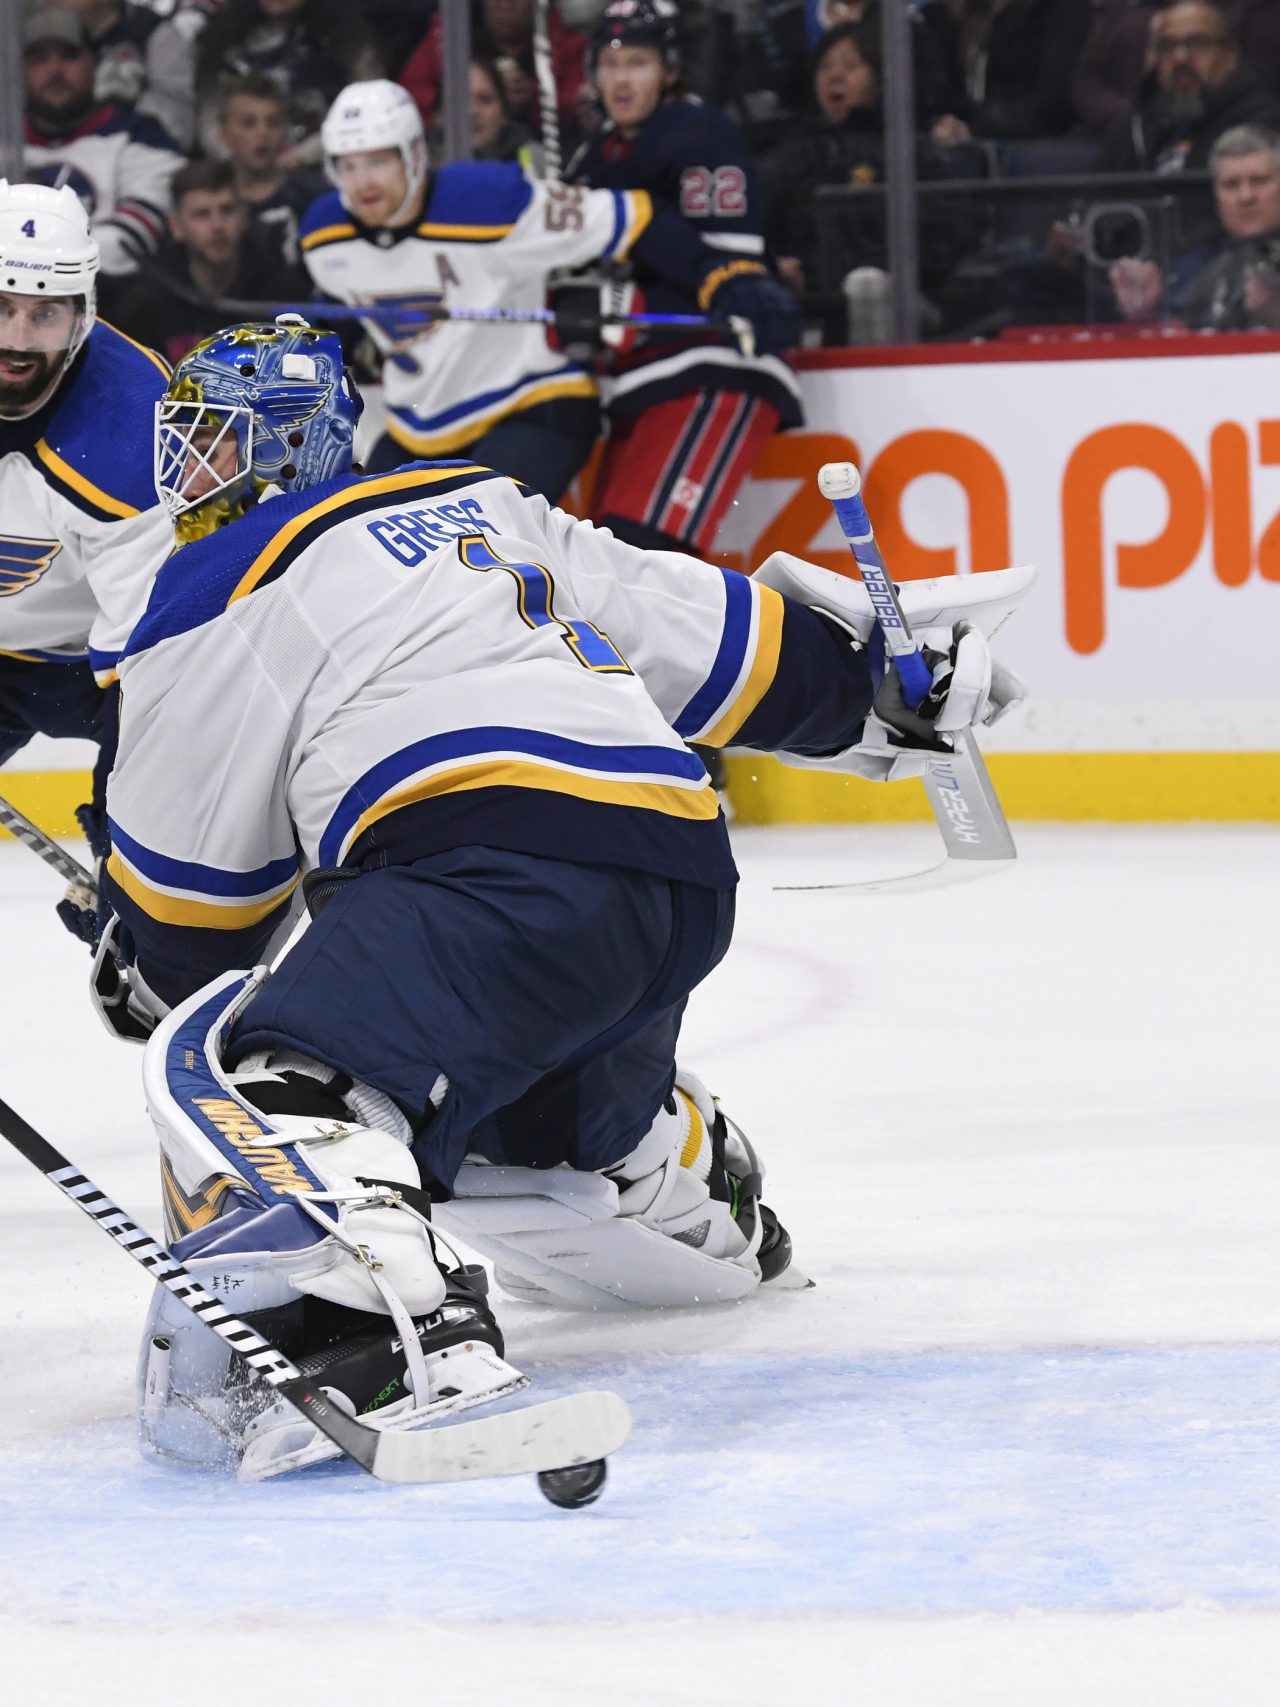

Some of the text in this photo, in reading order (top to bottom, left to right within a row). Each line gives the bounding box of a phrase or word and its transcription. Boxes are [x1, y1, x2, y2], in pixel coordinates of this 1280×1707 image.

[680, 165, 747, 217] 22
[21, 219, 36, 238] 4
[457, 533, 635, 675] 1
